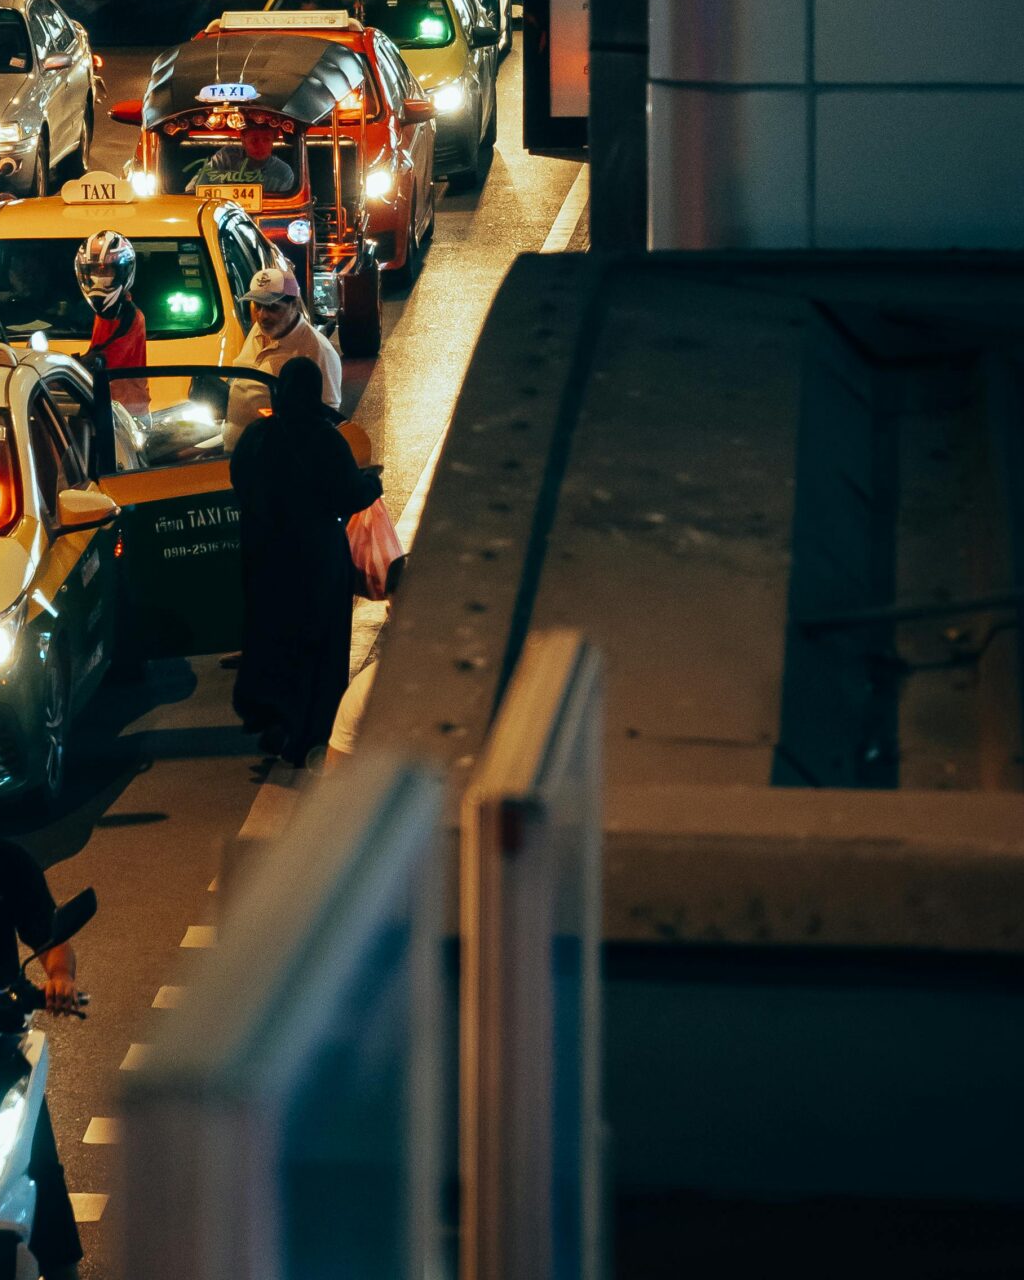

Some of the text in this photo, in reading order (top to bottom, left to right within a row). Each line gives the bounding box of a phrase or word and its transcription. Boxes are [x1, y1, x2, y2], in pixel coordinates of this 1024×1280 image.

[210, 87, 245, 96] TAXI
[182, 158, 265, 185] Fender
[81, 184, 116, 200] TAXI
[232, 188, 255, 200] 344
[187, 506, 222, 528] TAXI
